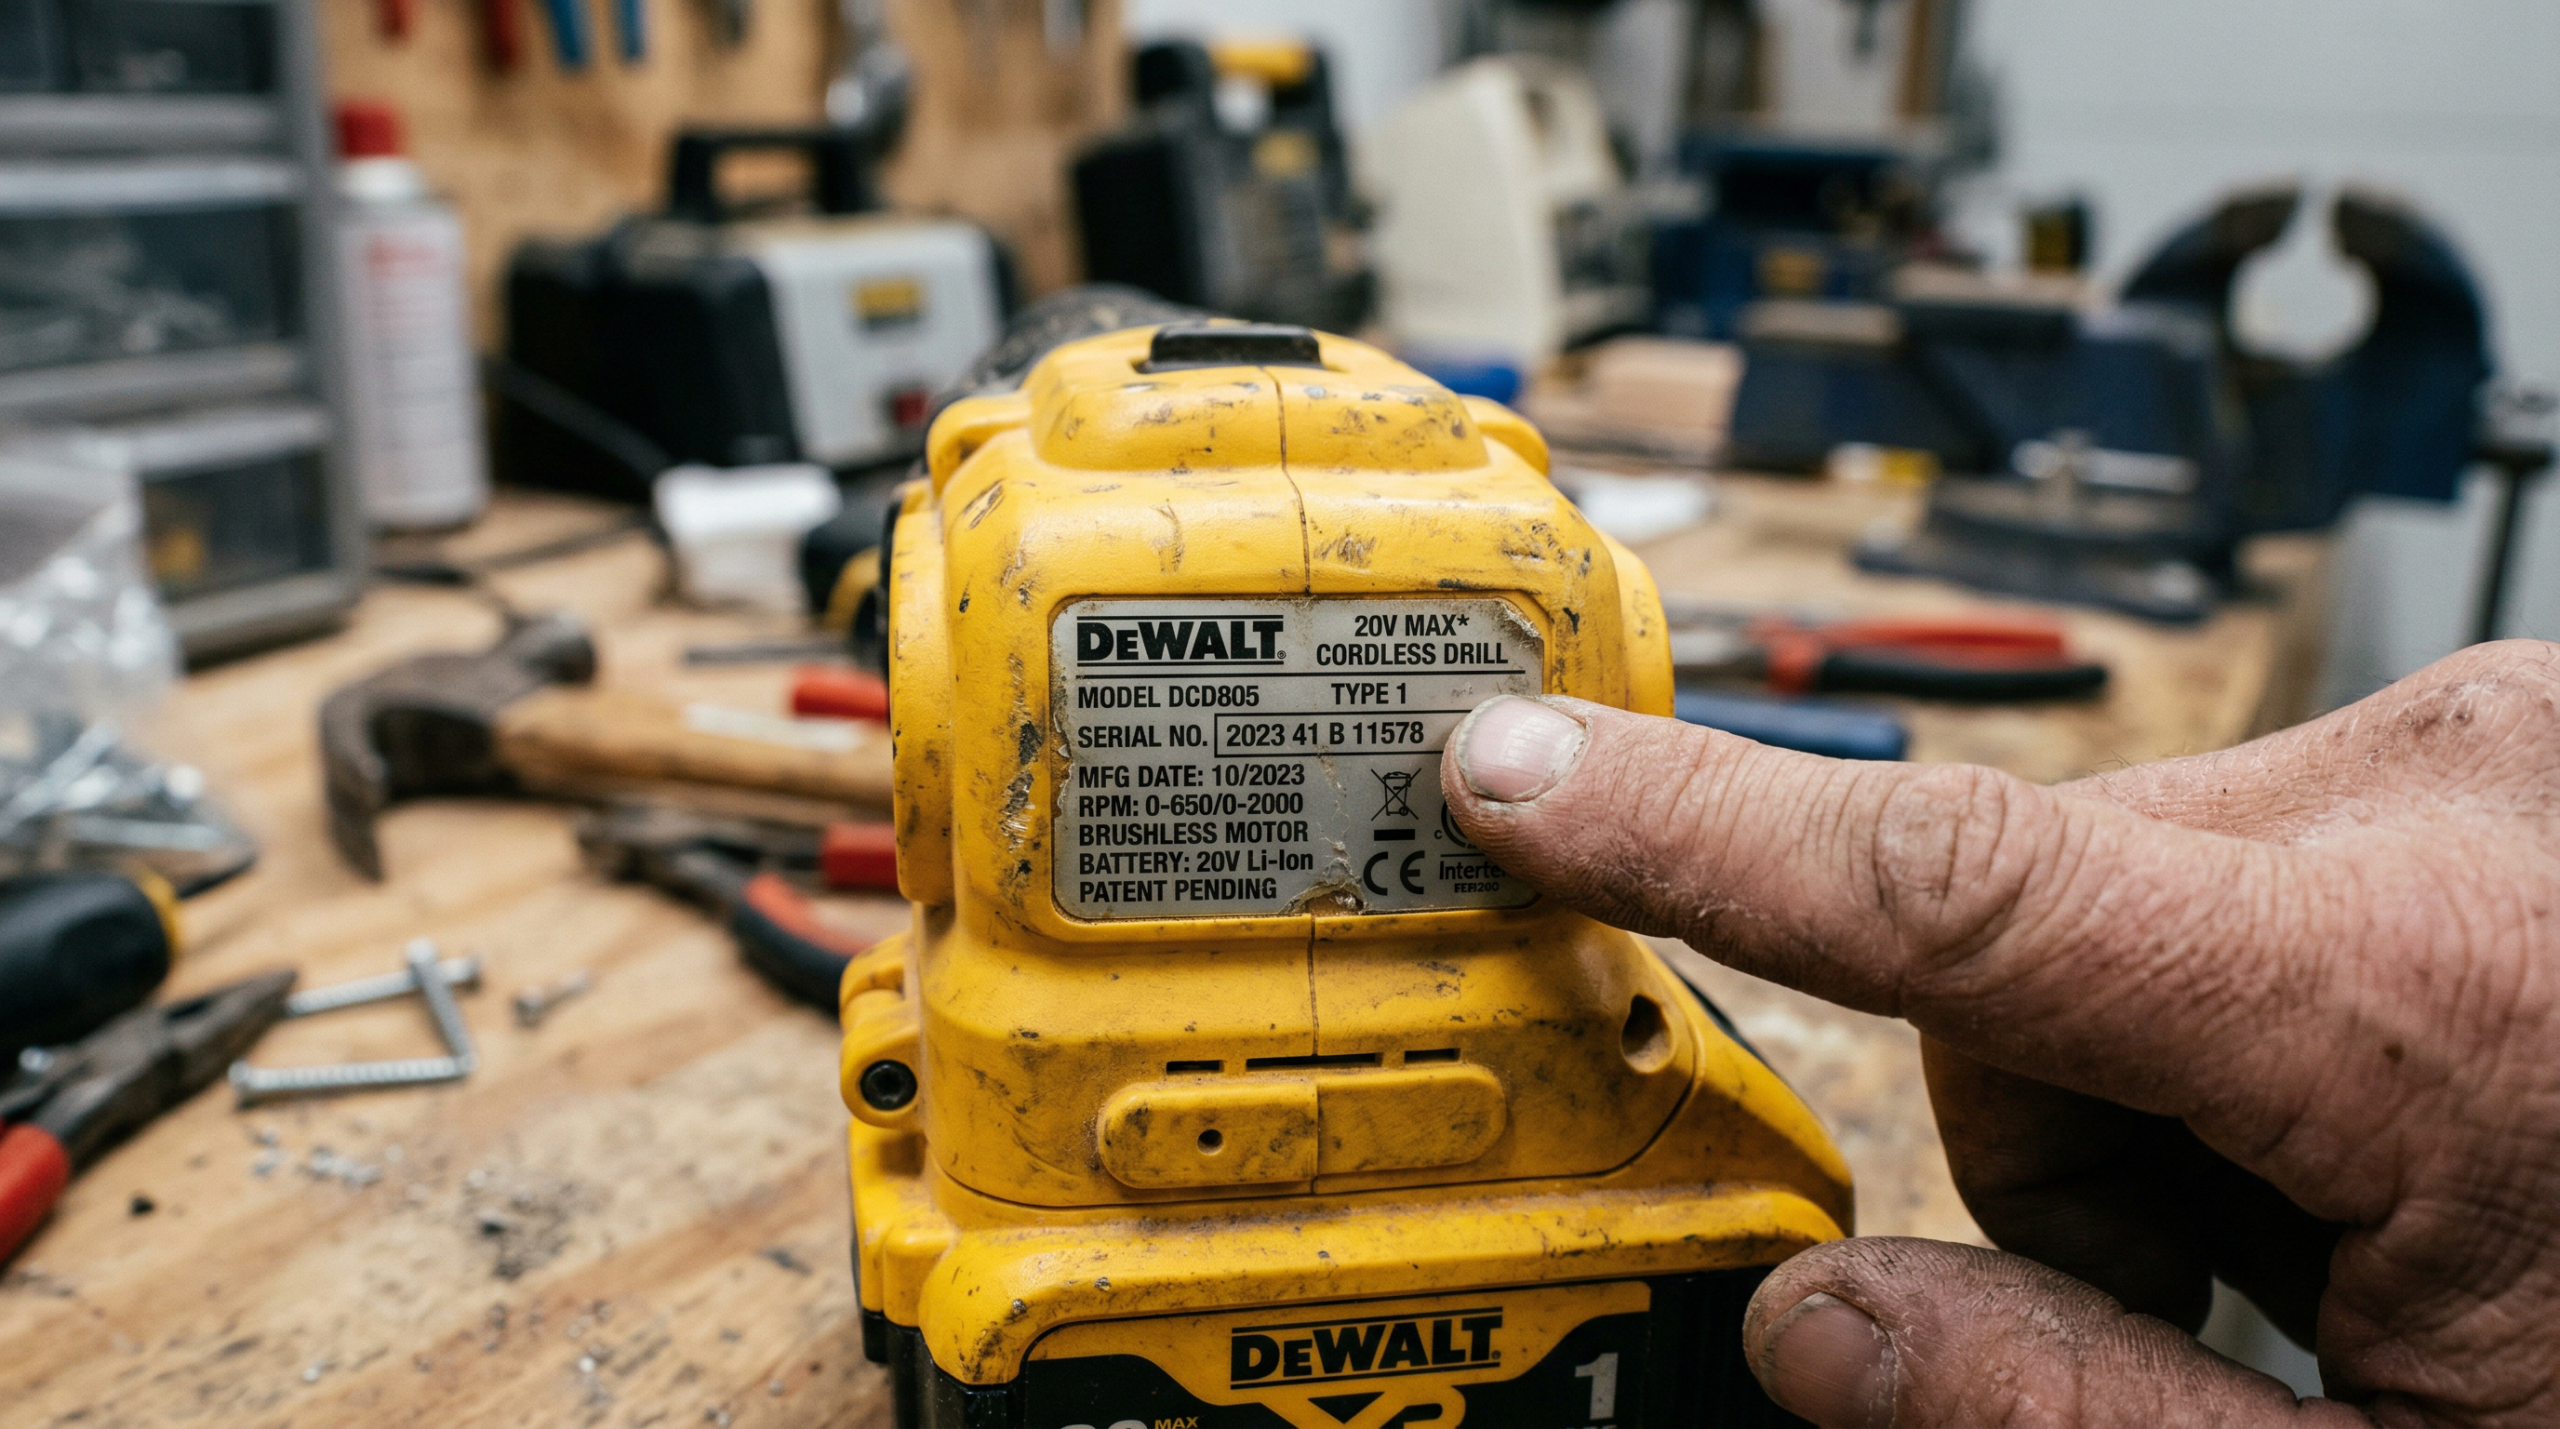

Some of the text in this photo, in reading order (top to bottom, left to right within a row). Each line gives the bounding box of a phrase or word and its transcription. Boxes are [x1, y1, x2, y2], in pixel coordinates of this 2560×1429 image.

[1354, 614, 1398, 637] 20V
[1316, 642, 1509, 667] CORDLESS DRILL
[1077, 684, 1260, 709] MODEL DCD805
[1330, 682, 1406, 706] TYPE 1
[1077, 720, 1425, 749] SERIAL NO. 2023 41 B 11578
[1078, 763, 1306, 789] MFG DATE: 10/2023
[1078, 792, 1305, 818] RPM: 0-650/0-2000
[1078, 819, 1309, 847] BRUSHLESS MOTOR
[1078, 848, 1315, 876] BATTERY: 20V Li-Ion
[1079, 877, 1278, 904] PATENT PENDING
[1575, 1352, 1619, 1421] 1
[1154, 1416, 1200, 1429] MAX
